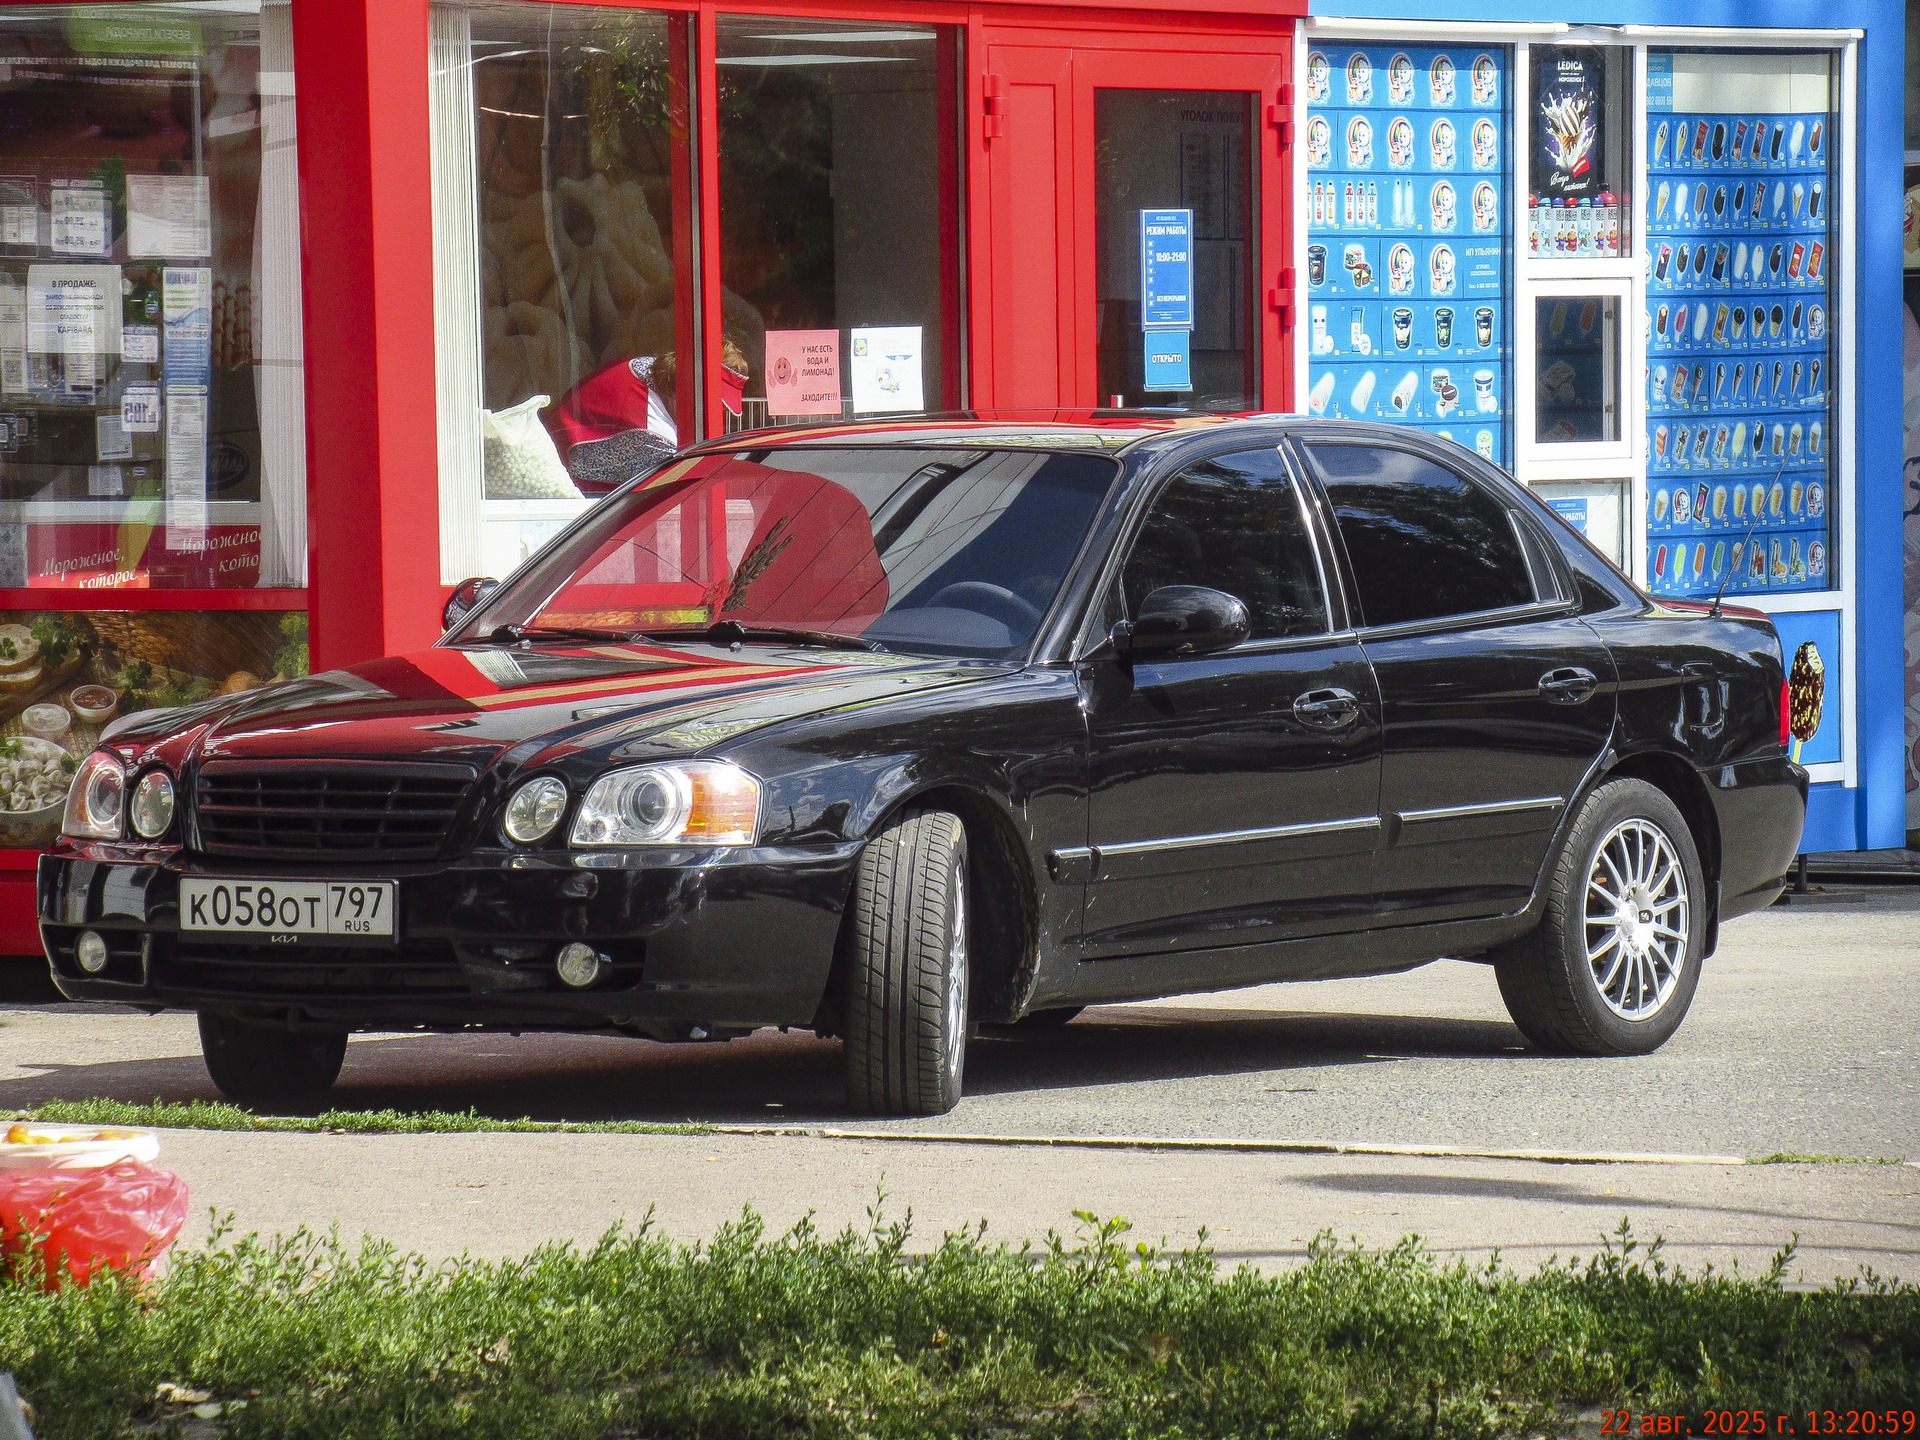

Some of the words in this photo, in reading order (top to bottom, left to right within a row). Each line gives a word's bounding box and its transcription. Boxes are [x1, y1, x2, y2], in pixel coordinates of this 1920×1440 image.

[1557, 60, 1583, 71] LEDICA
[1146, 226, 1166, 235] РЕЖИМ
[1166, 226, 1187, 235] РАБОТЫ
[58, 280, 97, 289] ПРОДАЖЕ:
[801, 345, 806, 354] У
[806, 357, 823, 365] ВОДА
[1151, 353, 1183, 364] ОТКРЫТО
[801, 367, 835, 377] ЛИМОНАД!
[801, 392, 838, 402] ЗАХОДИТЕ!!!
[190, 885, 321, 928] К058ОТ
[331, 886, 383, 918] 797
[344, 920, 370, 932] RUS
